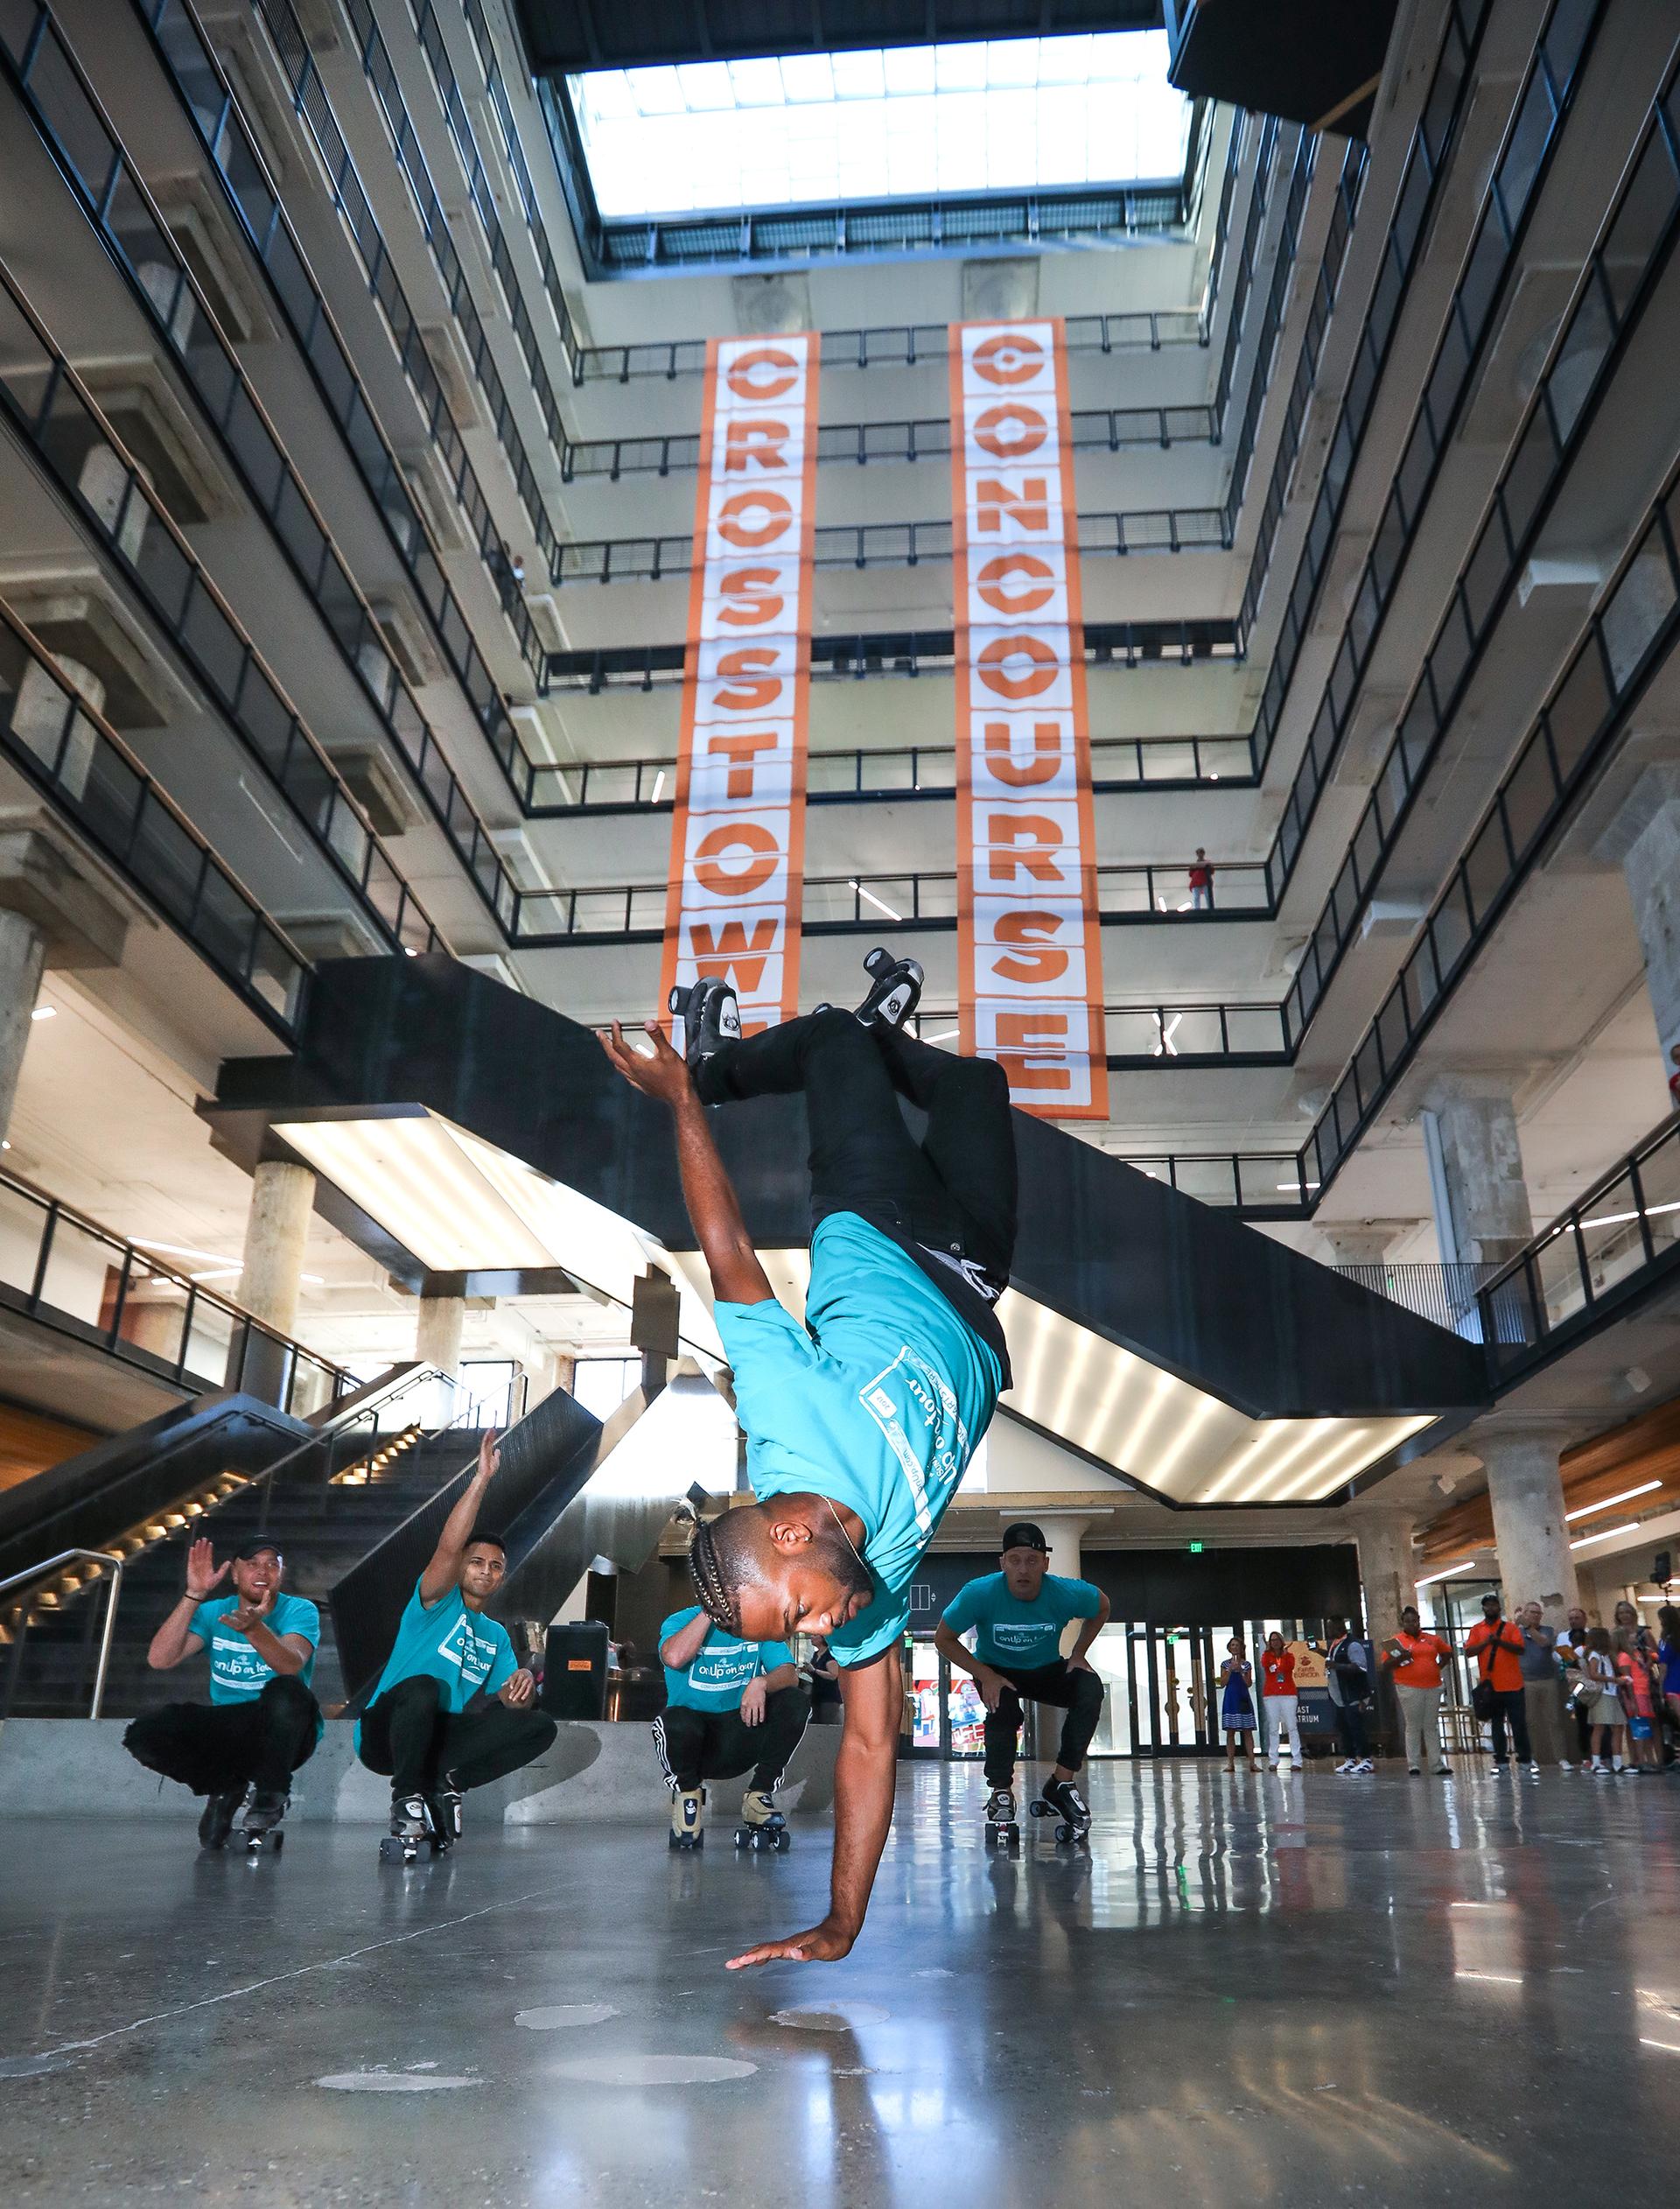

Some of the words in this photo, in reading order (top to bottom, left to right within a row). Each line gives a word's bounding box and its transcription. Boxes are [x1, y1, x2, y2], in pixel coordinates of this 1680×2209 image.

[689, 347, 800, 1040] CROSSTOW
[970, 333, 1072, 1091] CONCOURSE
[876, 1395, 891, 1411] 2017
[904, 1378, 937, 1427] tour
[725, 1666, 738, 1675] on
[1297, 1706, 1310, 1715] AST
